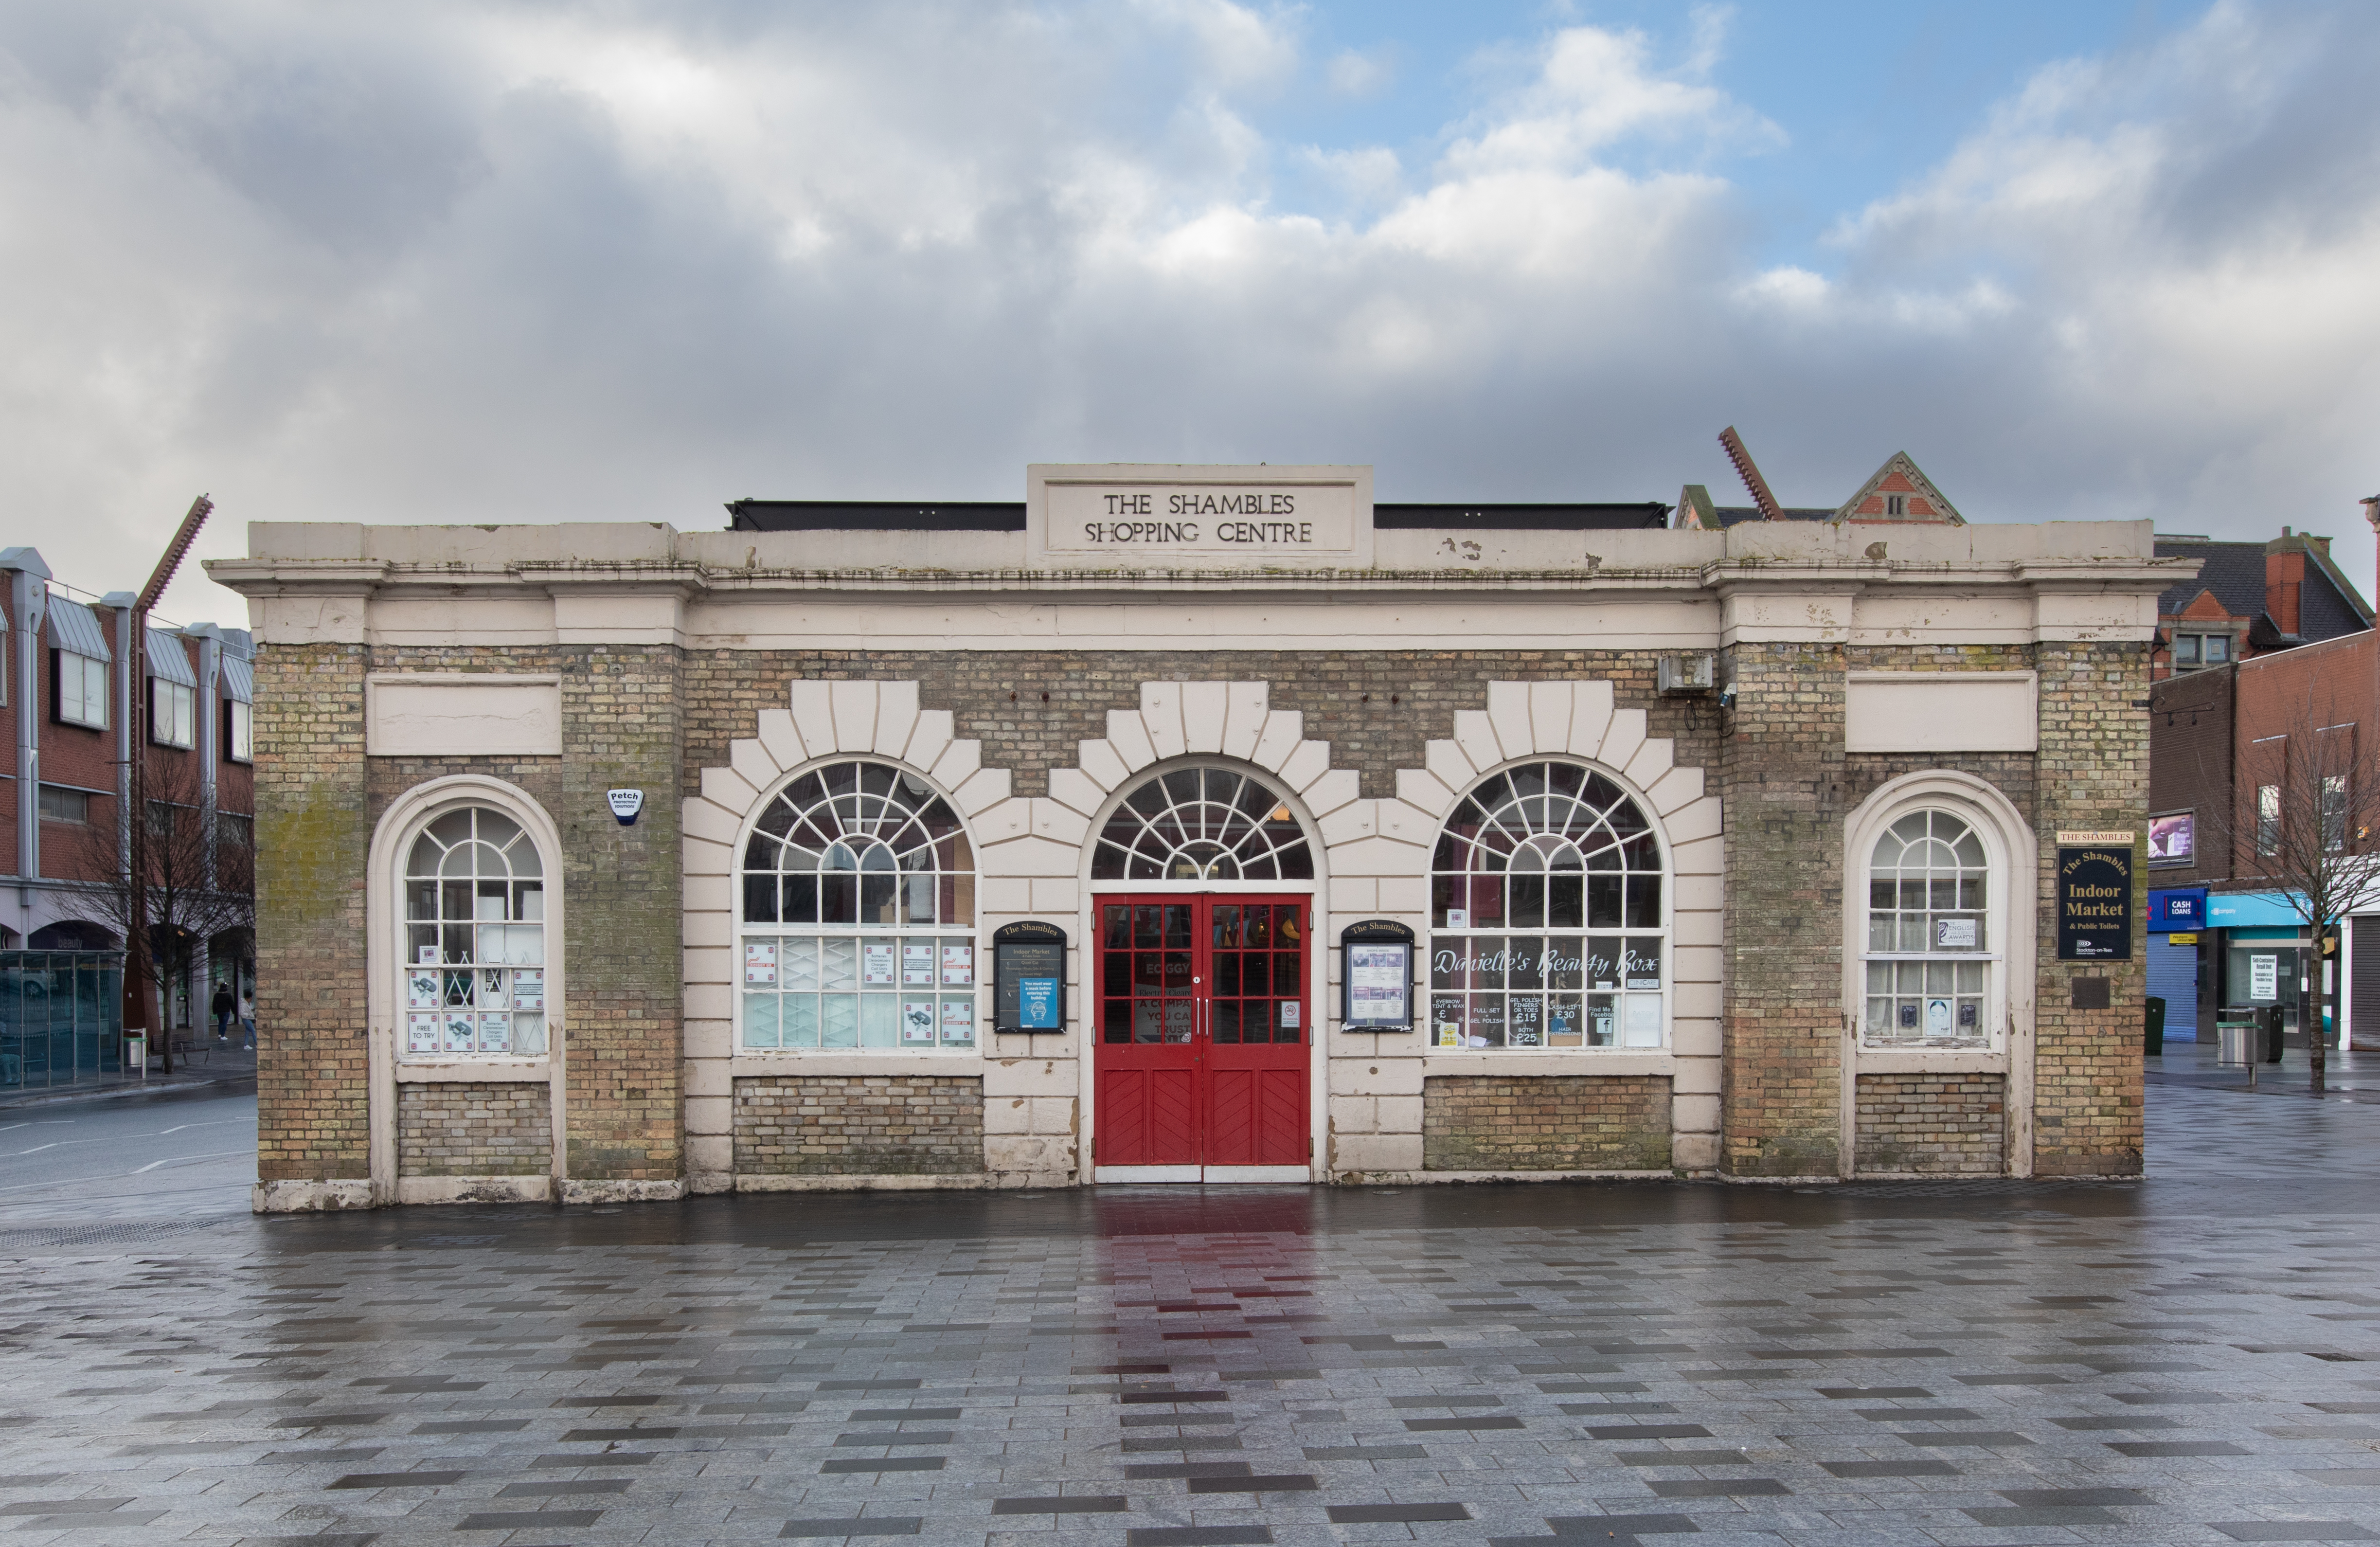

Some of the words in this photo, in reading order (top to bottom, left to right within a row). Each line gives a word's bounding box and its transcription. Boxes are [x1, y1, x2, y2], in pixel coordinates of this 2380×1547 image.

[1104, 495, 1151, 514] THE
[1170, 495, 1294, 514] SHAMBLES
[1085, 522, 1199, 542] SHOPPING
[1217, 522, 1312, 542] CENTRE
[2063, 859, 2081, 875] The
[2082, 851, 2128, 876] Shambles
[2069, 884, 2121, 897] Indoor
[2066, 902, 2124, 916] Market
[1003, 926, 1020, 935] The
[1021, 923, 1057, 936] Shambles
[1351, 925, 1367, 935] The
[1369, 922, 1405, 935] Shambles
[58, 936, 82, 949] beauty
[1146, 963, 1190, 974] ECGGY
[1434, 950, 1531, 973] Danielle's
[1537, 949, 1610, 978] Beauty
[1615, 950, 1659, 978] Box
[1174, 1012, 1191, 1021] CA
[1439, 1009, 1446, 1019] £
[1515, 1013, 1537, 1023] £15
[1556, 1010, 1575, 1019] £30
[1516, 1033, 1537, 1043] £25
